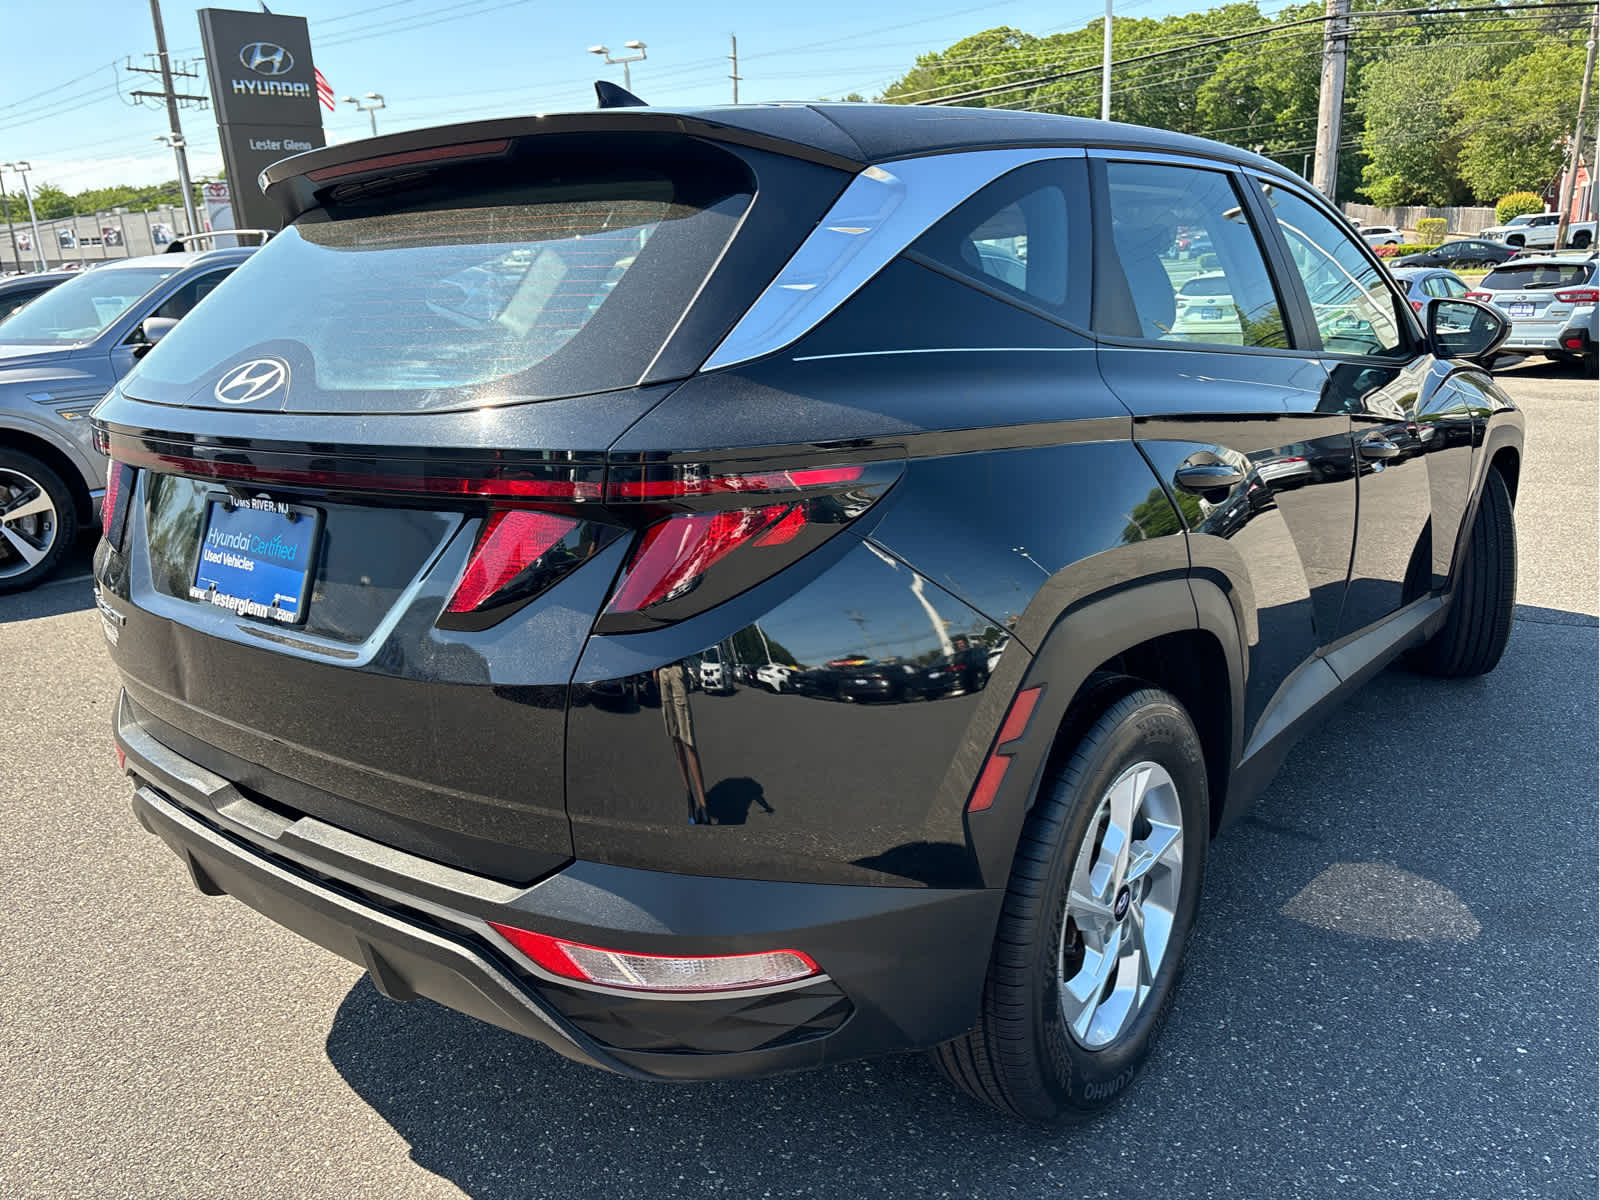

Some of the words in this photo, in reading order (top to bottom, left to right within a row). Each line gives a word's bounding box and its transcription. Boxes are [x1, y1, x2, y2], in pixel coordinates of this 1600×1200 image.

[232, 79, 311, 97] HYUNDAI
[249, 139, 281, 151] Lester
[283, 139, 312, 151] Glenn
[278, 503, 289, 514] NJ
[207, 527, 252, 551] Hyundai
[250, 535, 297, 561] Certified
[204, 548, 223, 564] Used
[223, 552, 255, 571] Vehicles
[1084, 1064, 1134, 1100] KUMHO
